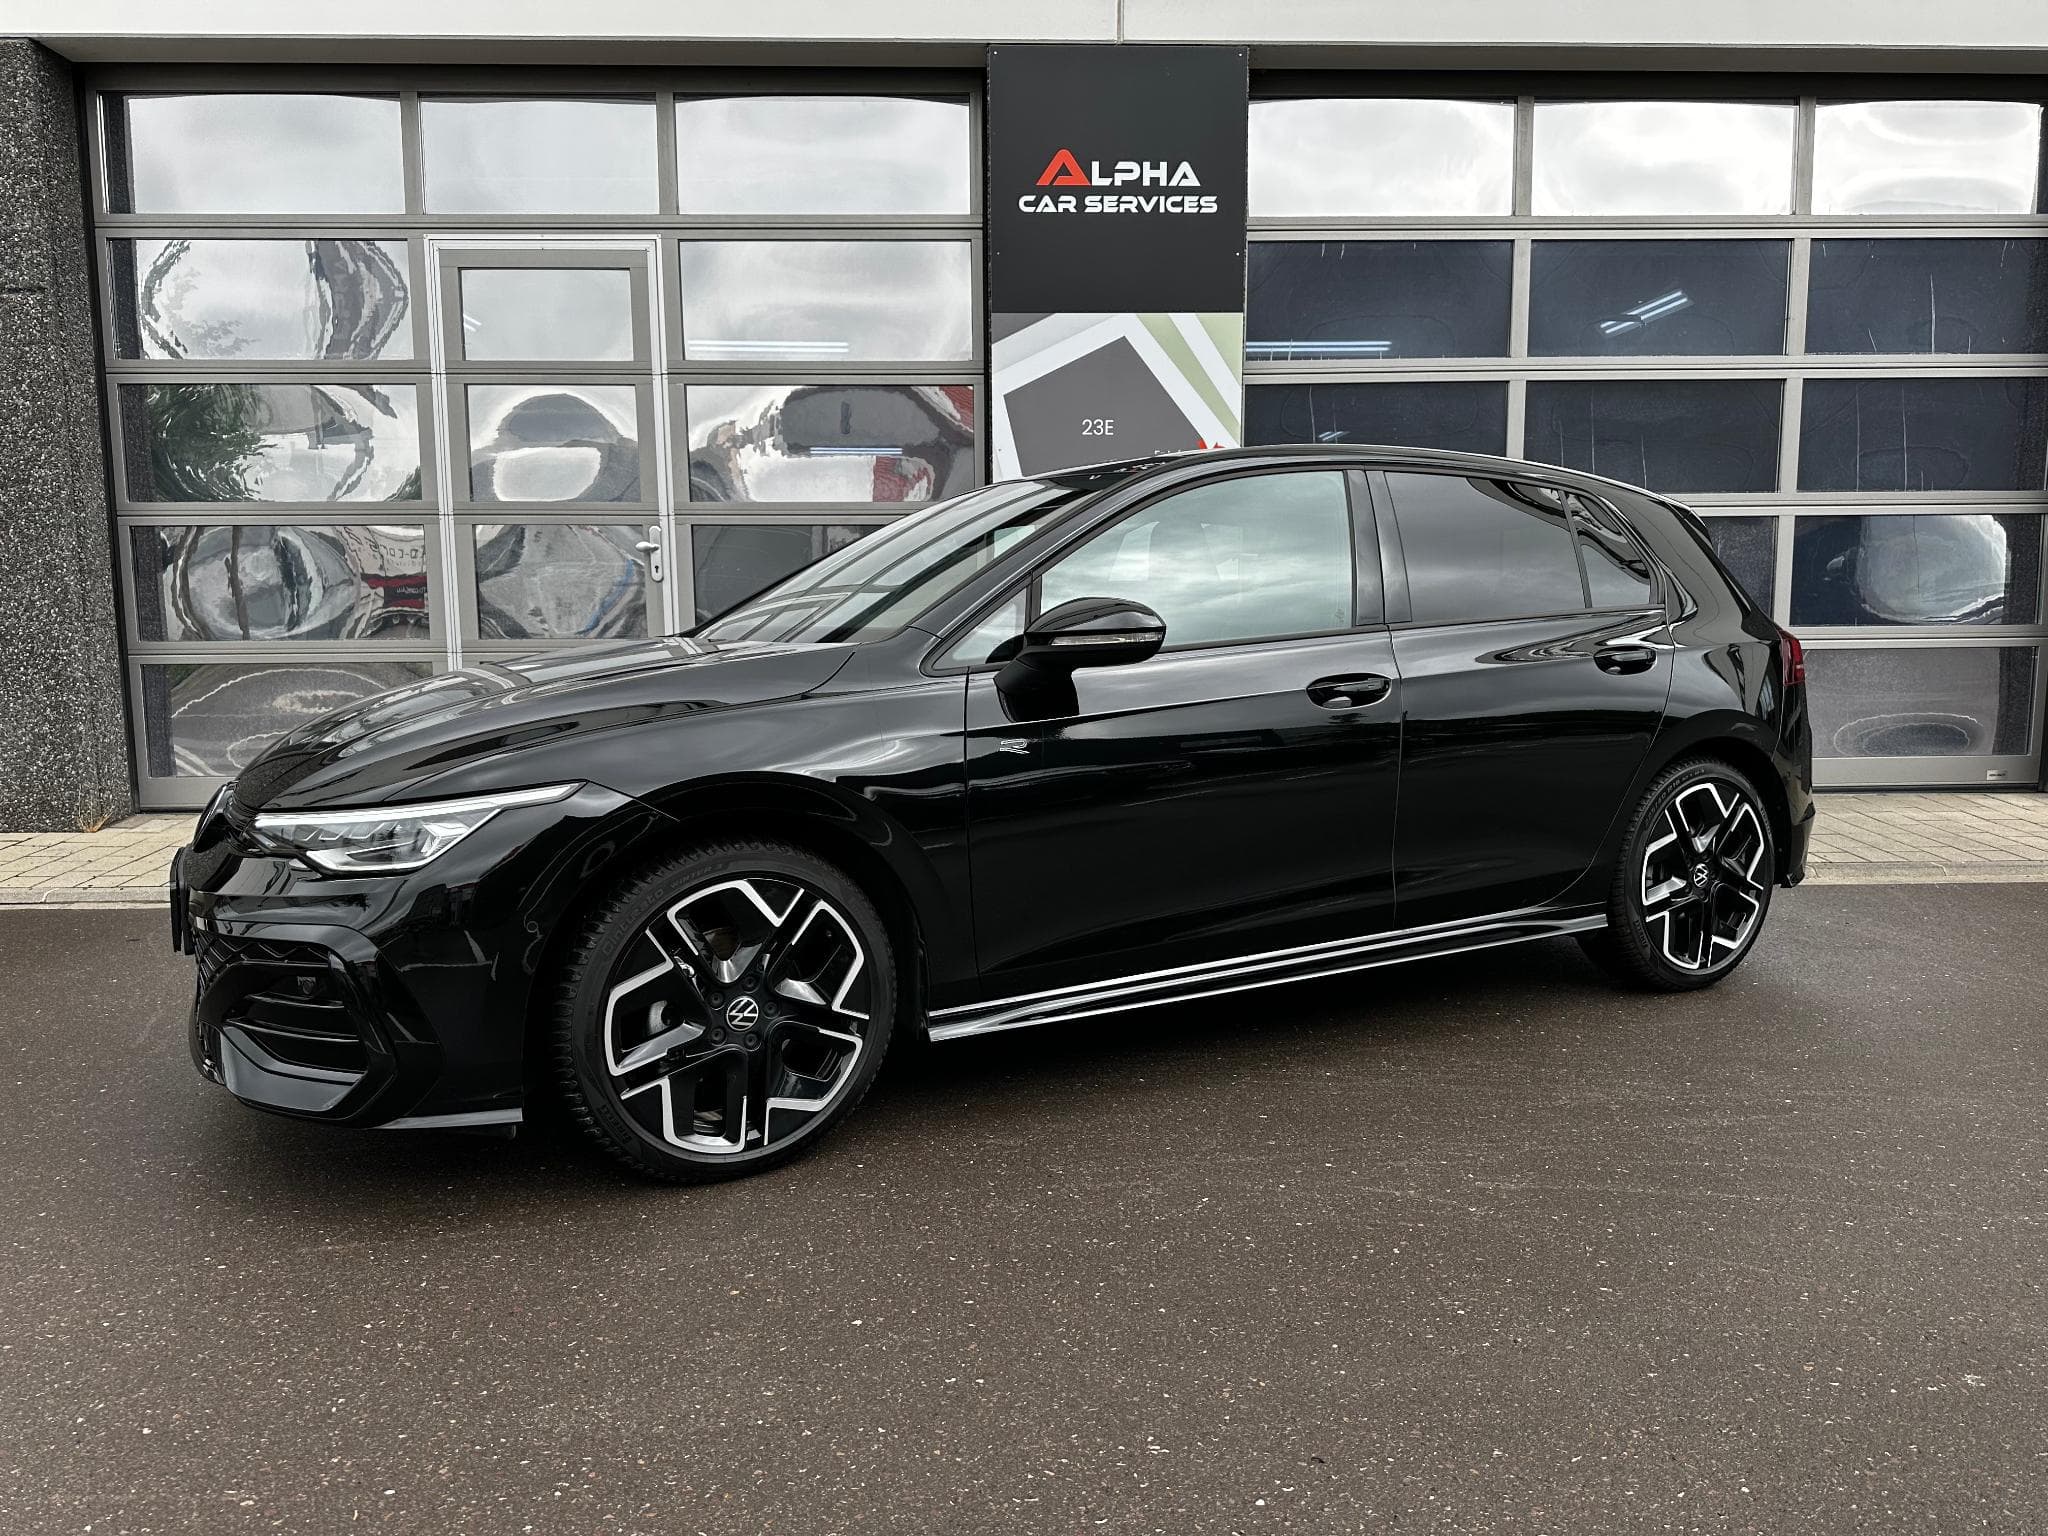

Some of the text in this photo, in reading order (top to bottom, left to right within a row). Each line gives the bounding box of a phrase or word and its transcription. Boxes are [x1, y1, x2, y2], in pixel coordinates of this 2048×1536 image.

[1035, 148, 1202, 187] ALPHA
[1018, 195, 1218, 213] CAR SERVICES
[1081, 419, 1114, 436] 23E
